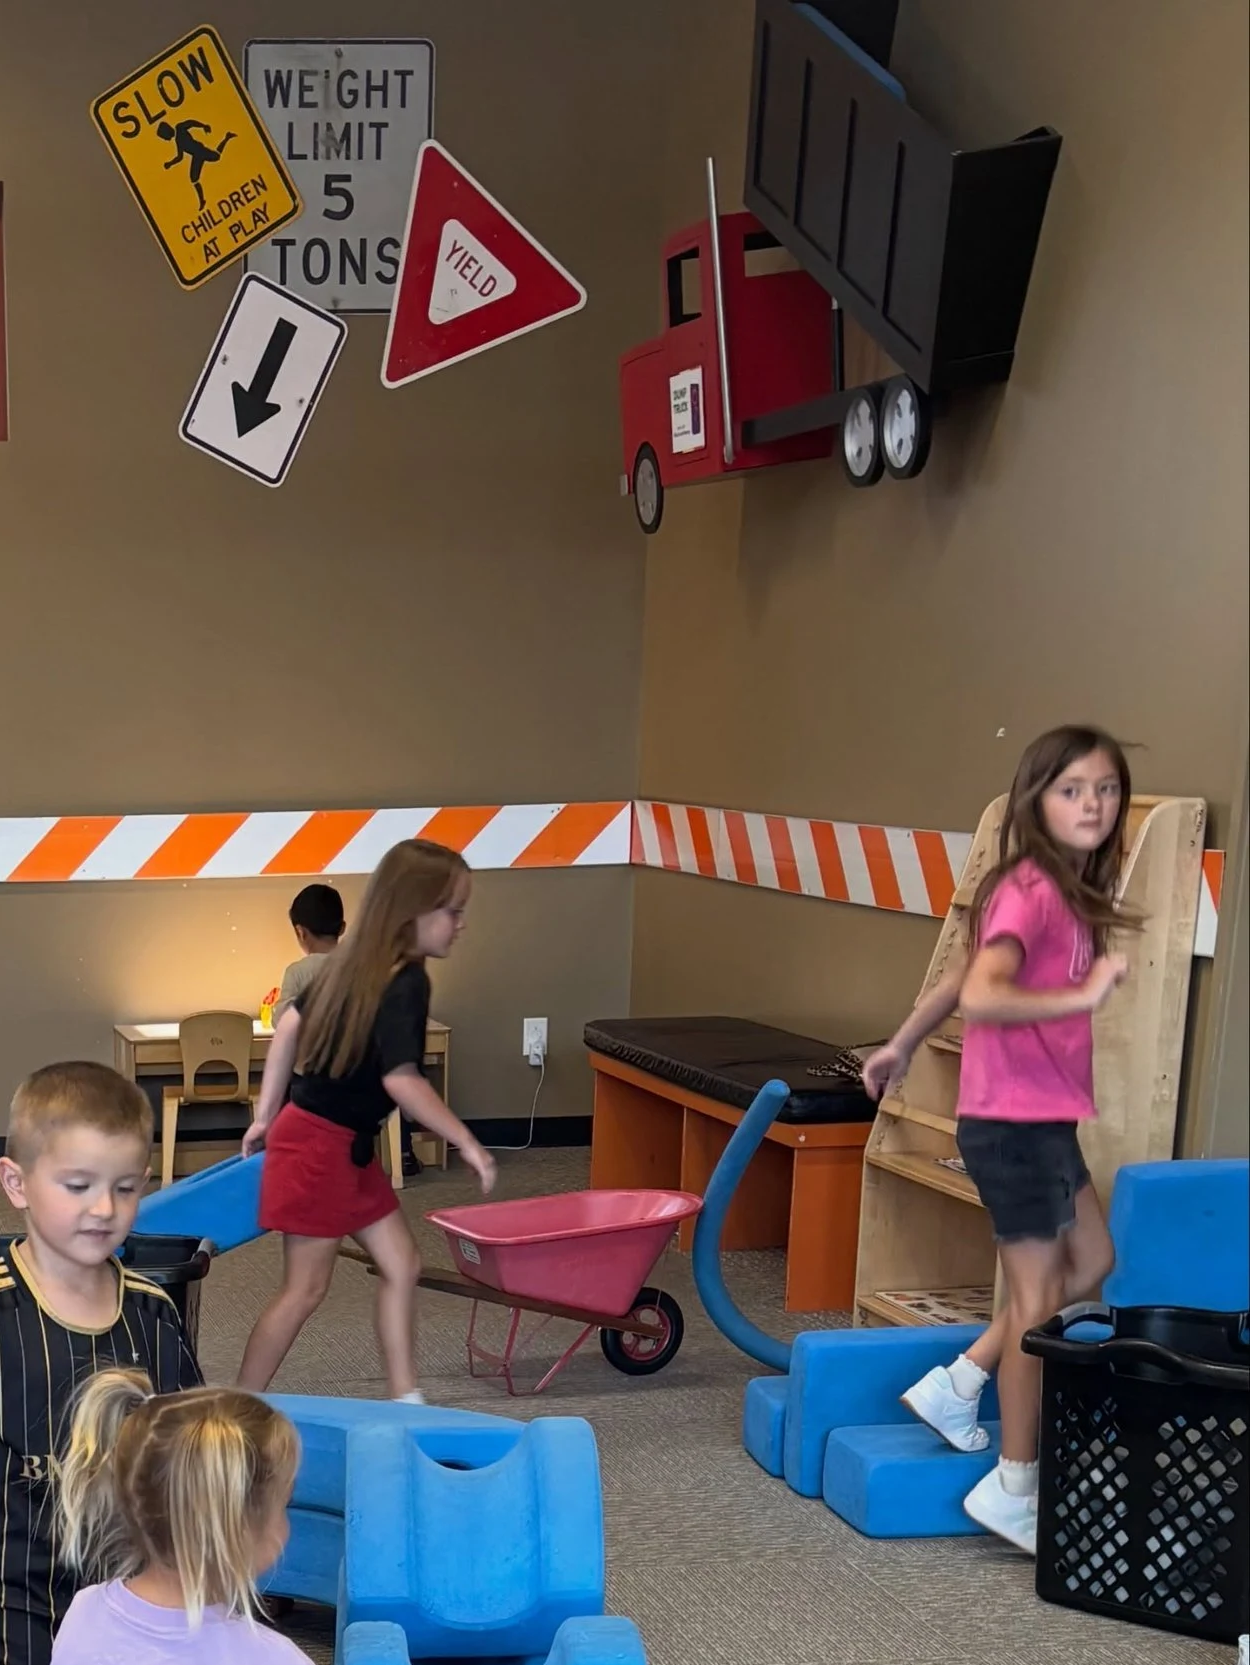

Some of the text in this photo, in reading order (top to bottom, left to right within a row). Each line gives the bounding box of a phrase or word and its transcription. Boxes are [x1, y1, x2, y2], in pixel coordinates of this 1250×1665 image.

[112, 46, 214, 139] SLOW
[287, 121, 389, 161] LIMIT
[181, 174, 268, 244] CHILDREN
[322, 173, 355, 221] 5
[202, 202, 270, 264] AT PLAY
[271, 237, 401, 286] TONS
[445, 239, 497, 297] YIELD
